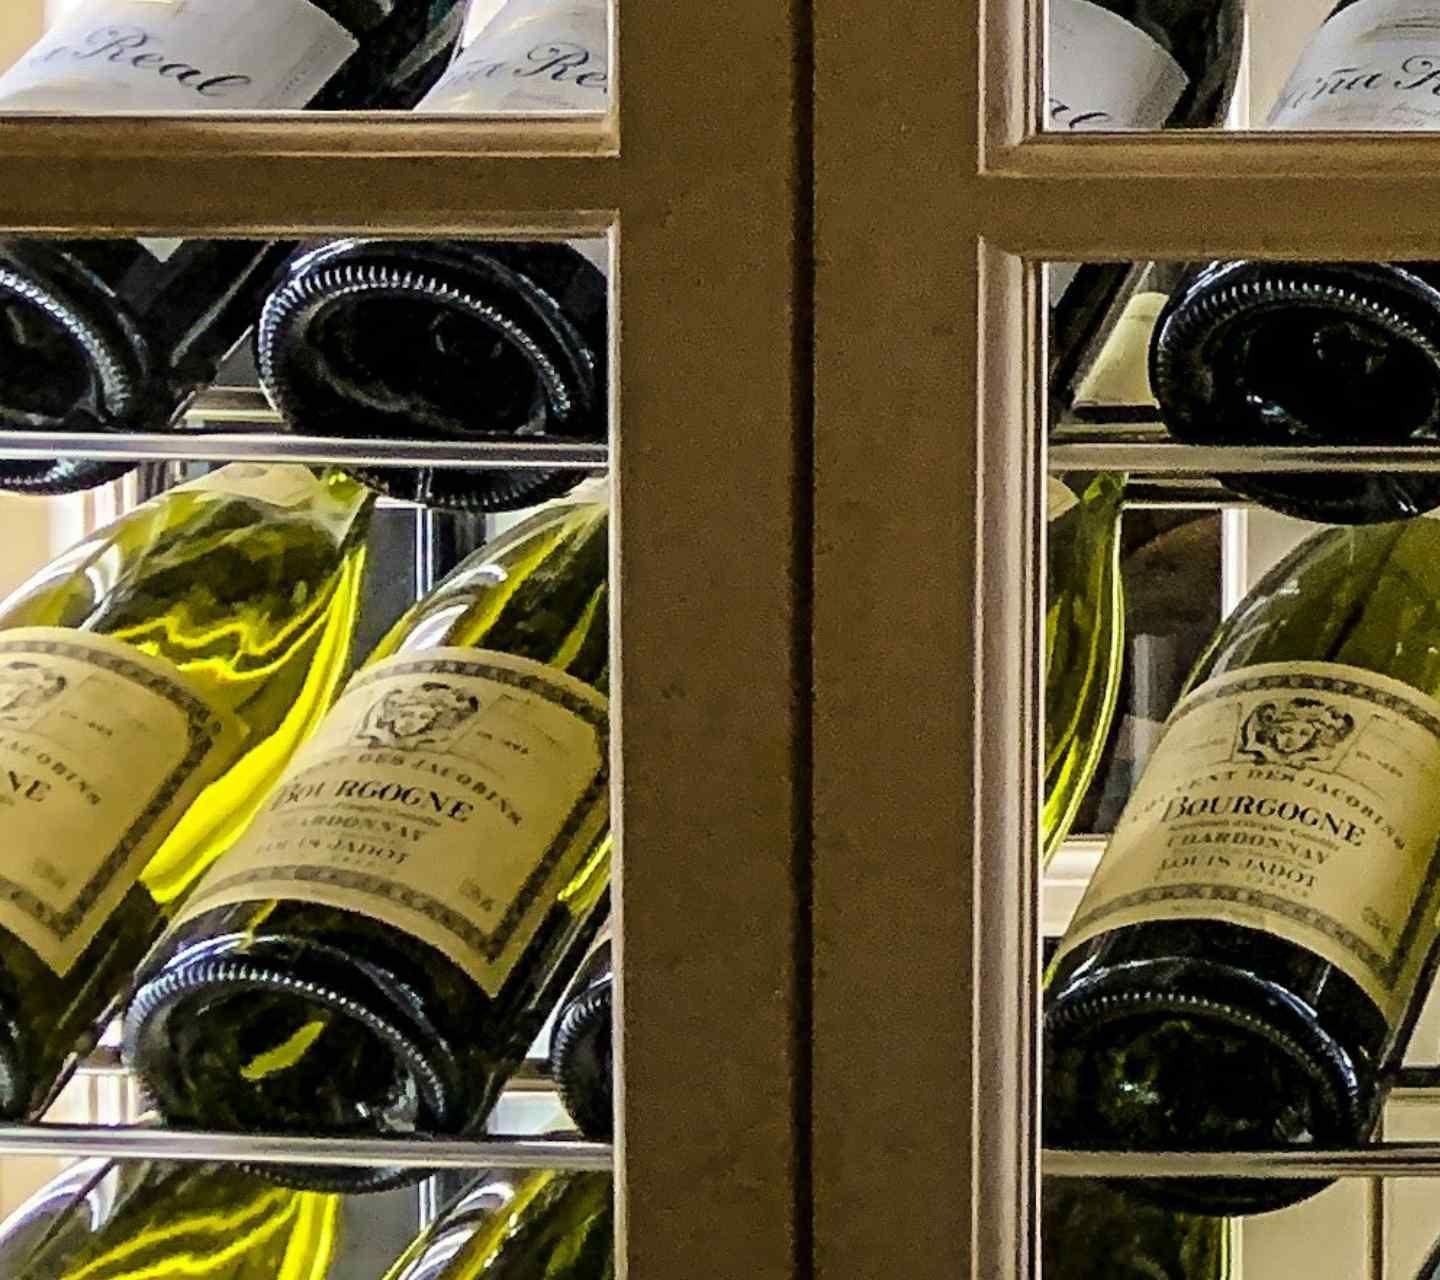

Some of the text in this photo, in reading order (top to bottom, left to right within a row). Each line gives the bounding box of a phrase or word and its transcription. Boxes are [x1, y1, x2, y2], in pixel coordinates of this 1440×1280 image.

[76, 24, 254, 98] Real
[1160, 793, 1368, 849] BOURGOGNE
[1247, 768, 1297, 784] DES
[1302, 775, 1407, 852] JACOBINS
[1160, 854, 1321, 890] LOUIS JADOT
[1166, 829, 1332, 867] CHARDONNAY
